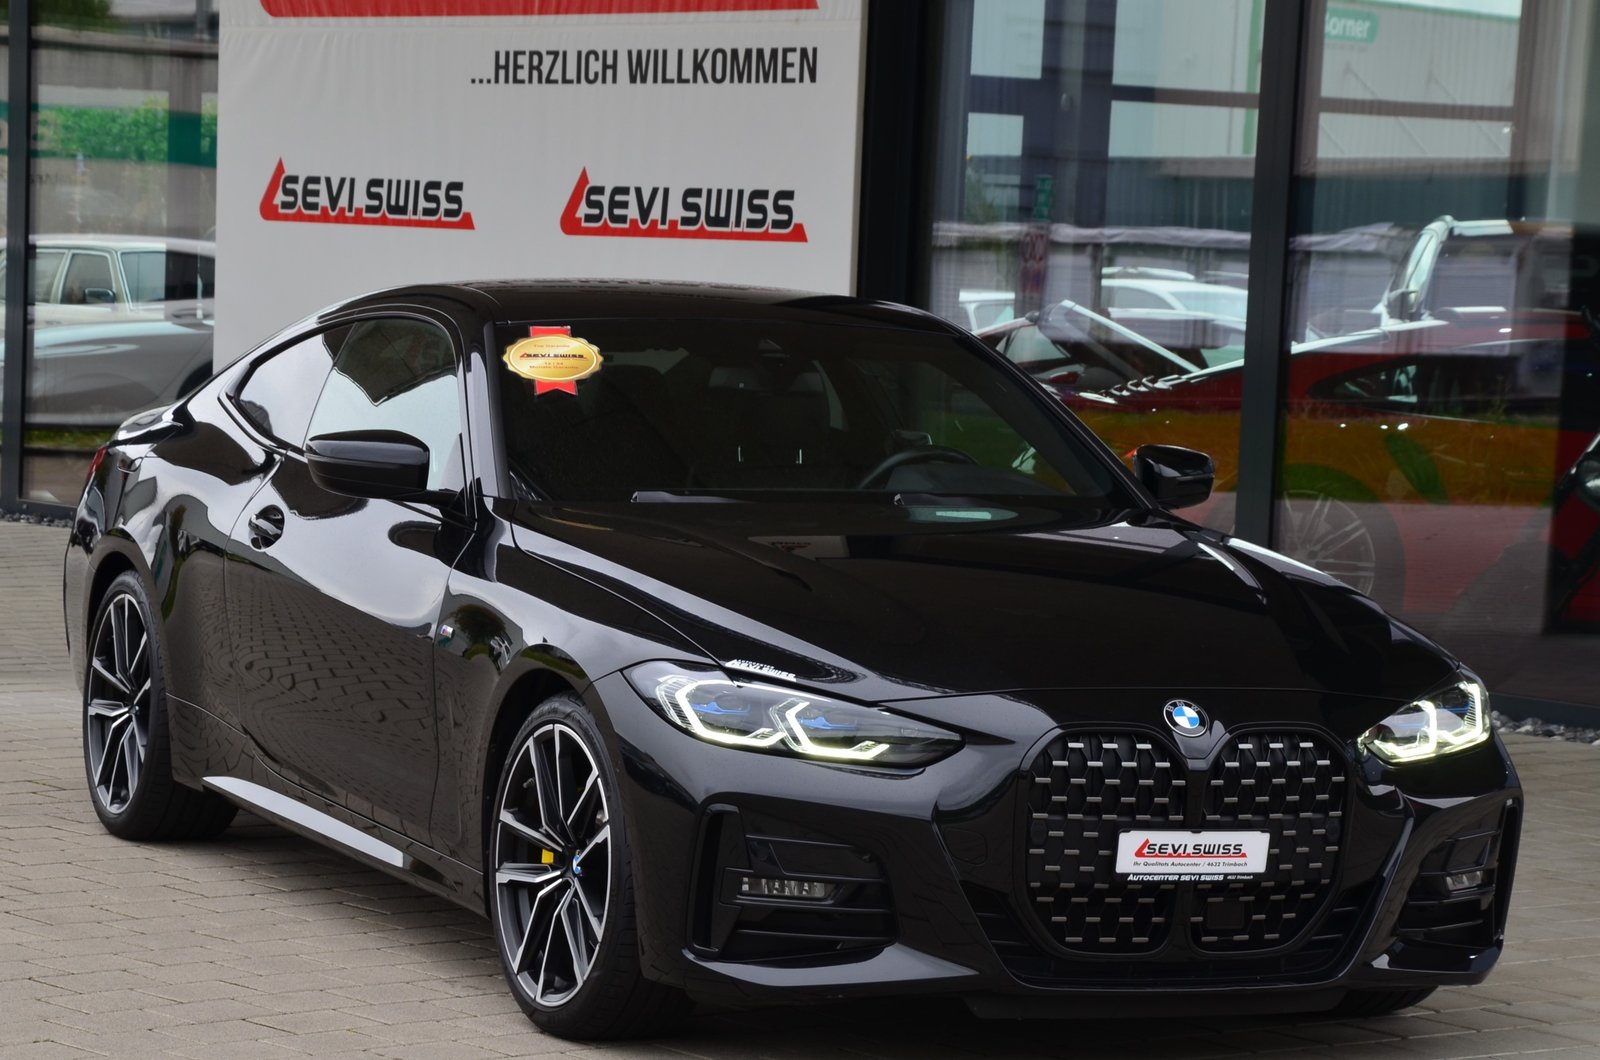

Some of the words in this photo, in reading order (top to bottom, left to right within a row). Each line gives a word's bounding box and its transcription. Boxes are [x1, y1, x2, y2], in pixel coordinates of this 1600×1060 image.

[470, 49, 618, 85] ...HERZLICH
[627, 46, 818, 84] WILLKOMMEN
[279, 174, 356, 214] SEVI
[364, 177, 464, 218] SWISS
[583, 185, 670, 227] SEVI
[680, 187, 795, 230] SWISS
[1166, 701, 1200, 712] BMW
[1146, 843, 1188, 855] SEVI
[1191, 843, 1243, 855] SWISS
